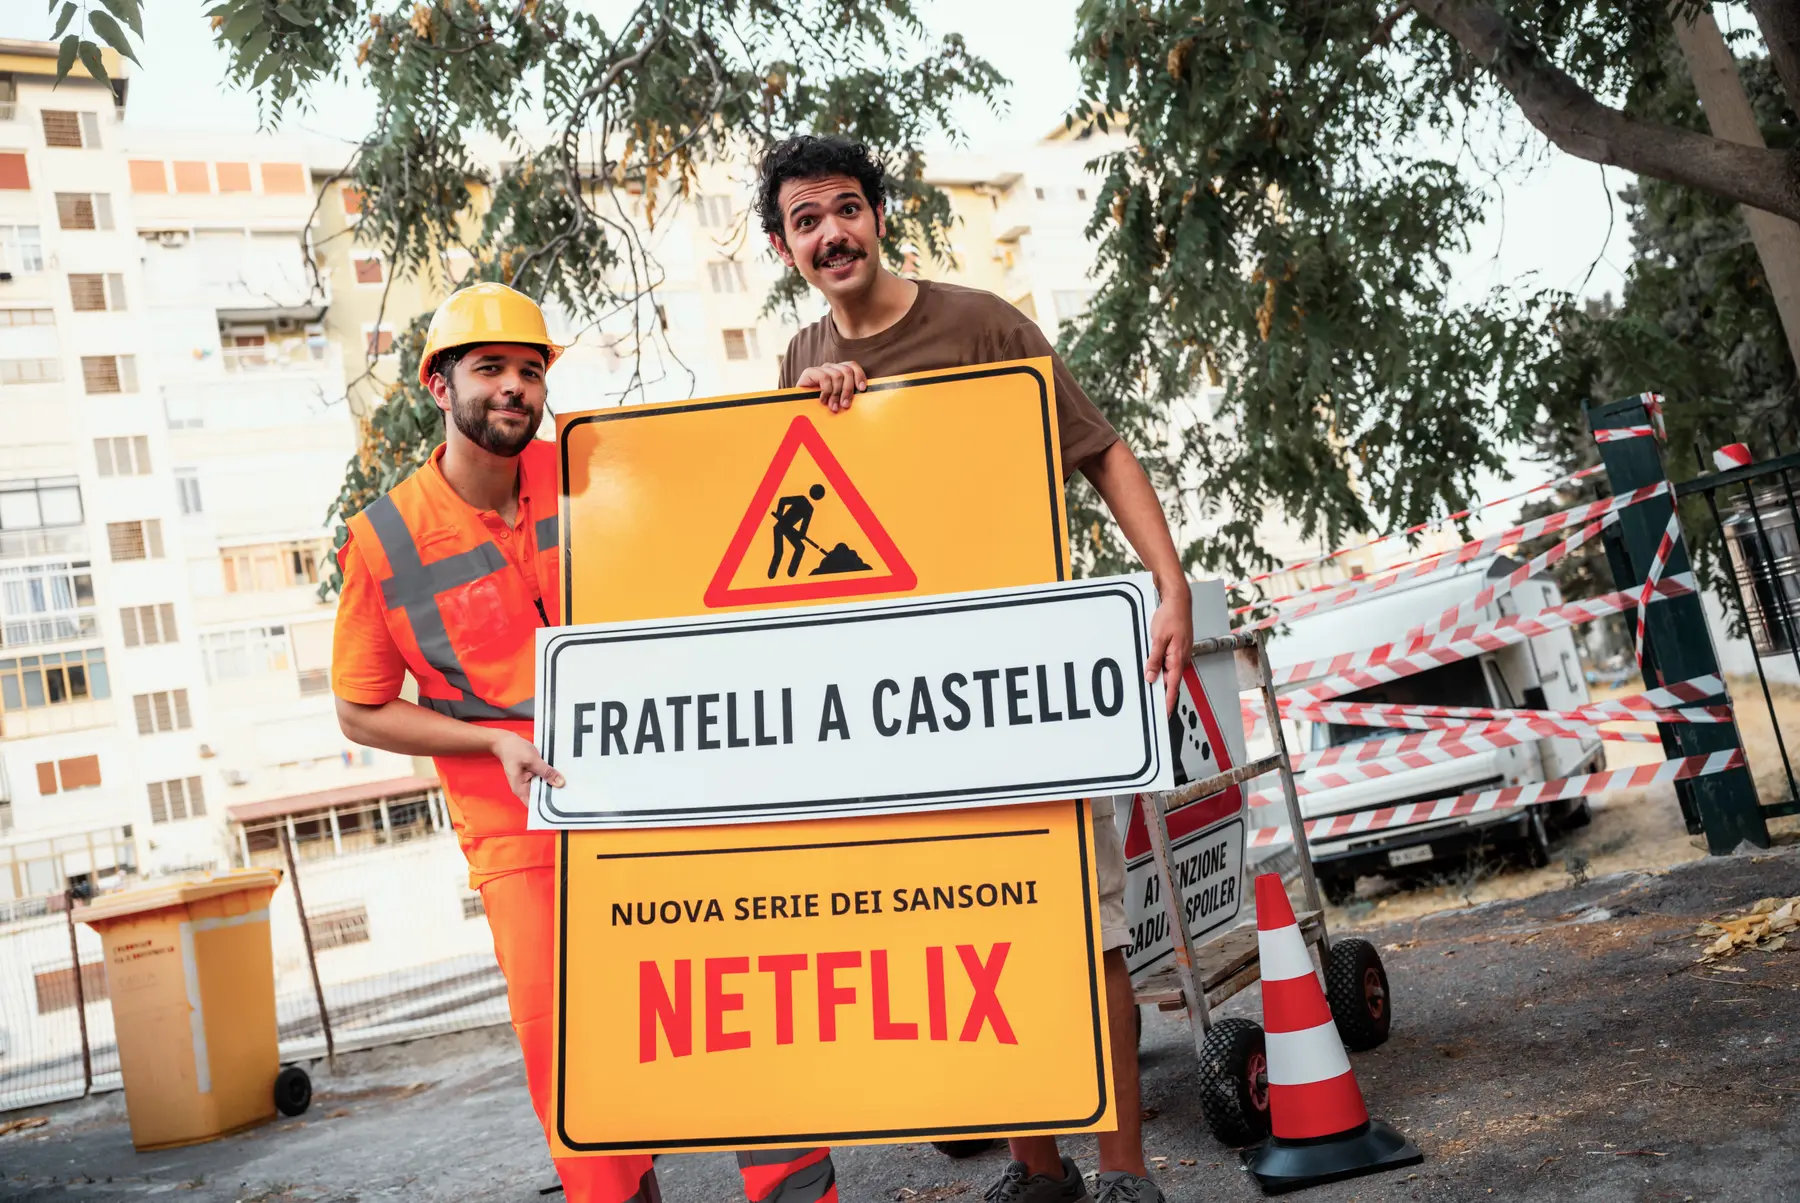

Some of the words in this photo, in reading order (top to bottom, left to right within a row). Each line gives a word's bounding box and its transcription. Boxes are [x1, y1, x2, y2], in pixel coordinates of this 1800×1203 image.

[573, 687, 793, 758] FRATELLI
[818, 683, 851, 742] A
[872, 657, 1124, 737] CASTELLO
[612, 899, 724, 926] NUOVA
[734, 893, 819, 921] SERIE
[831, 890, 883, 916] DEI
[893, 880, 1038, 912] SANSONI
[1143, 841, 1227, 909] ATNZIONE
[1185, 875, 1236, 925] SPOILER
[639, 942, 1019, 1064] NETFLIX
